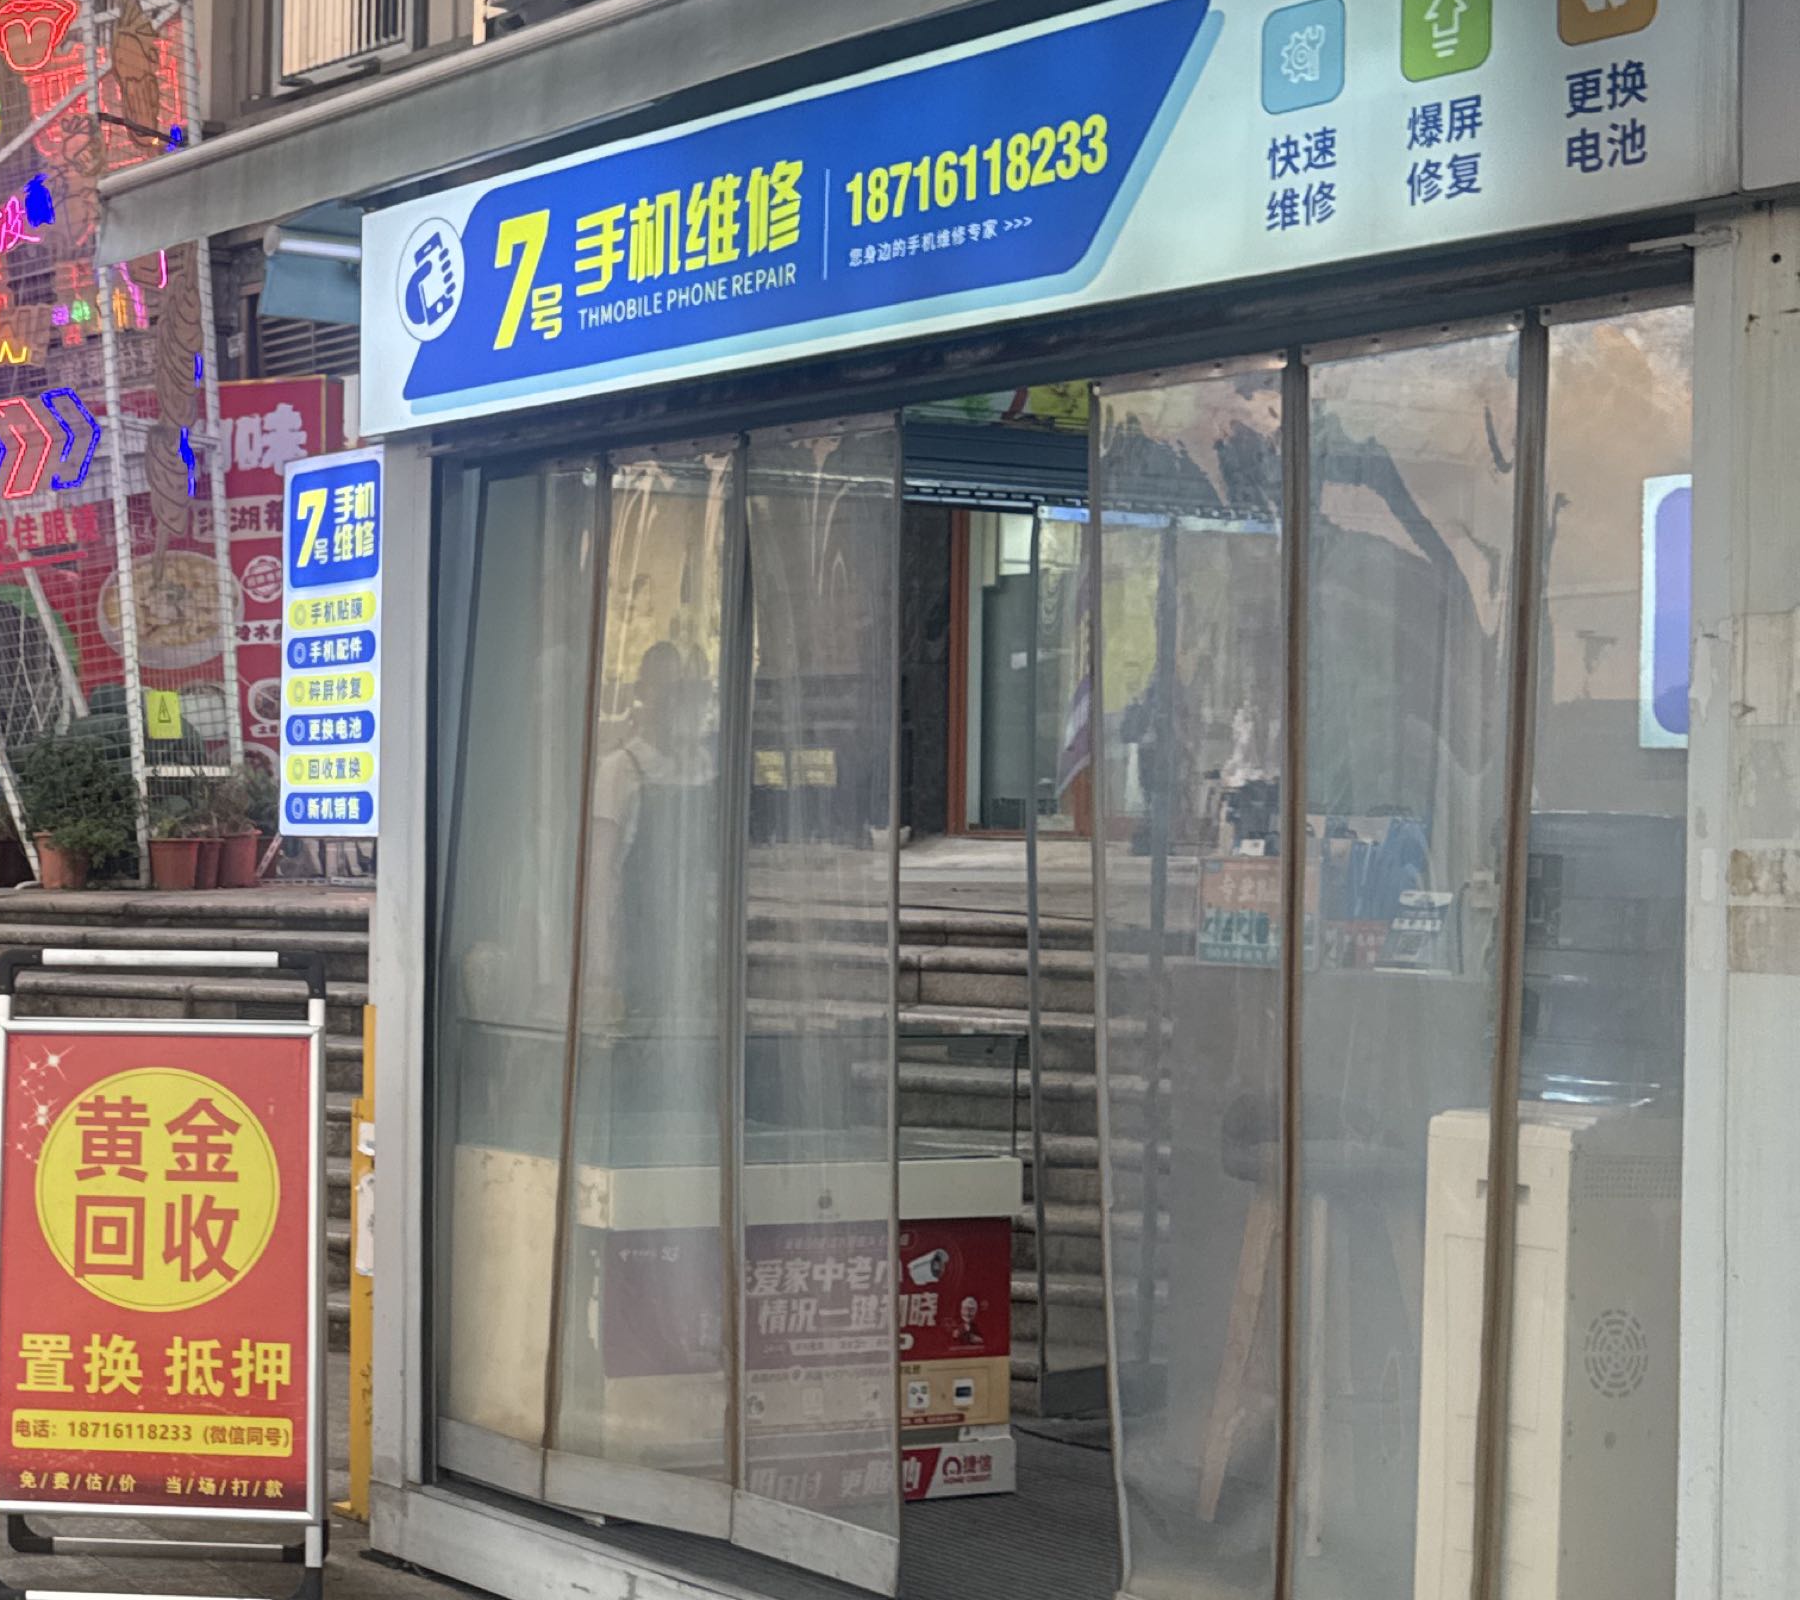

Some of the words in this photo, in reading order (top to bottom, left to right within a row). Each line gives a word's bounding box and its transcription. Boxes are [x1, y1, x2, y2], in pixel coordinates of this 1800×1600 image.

[1564, 60, 1648, 118] 更换
[1406, 95, 1483, 150] 爆屏
[1564, 119, 1649, 175] 电池
[846, 114, 1109, 226] 18716118233
[1267, 127, 1338, 181] 快速
[1406, 153, 1482, 206] 修复
[574, 159, 804, 297] 手机维修
[1265, 181, 1337, 232] 维修
[577, 291, 663, 330] THMOBILE
[666, 277, 729, 312] PHONE
[731, 262, 798, 300] REPAIR
[332, 481, 376, 525] 手机
[332, 521, 376, 564] 维修
[310, 597, 363, 625] 手机贴膜
[308, 637, 363, 663] 手机配件
[308, 719, 362, 742] 更换电池
[307, 757, 361, 780] 回收置换
[306, 797, 360, 821] 新机销售
[74, 1095, 243, 1183] 黄金
[73, 1193, 240, 1283] 回收
[745, 1255, 903, 1296] 爱家中老小
[16, 1333, 143, 1396] 置换
[163, 1335, 293, 1401] 抵押
[66, 1421, 194, 1442] 18716118233
